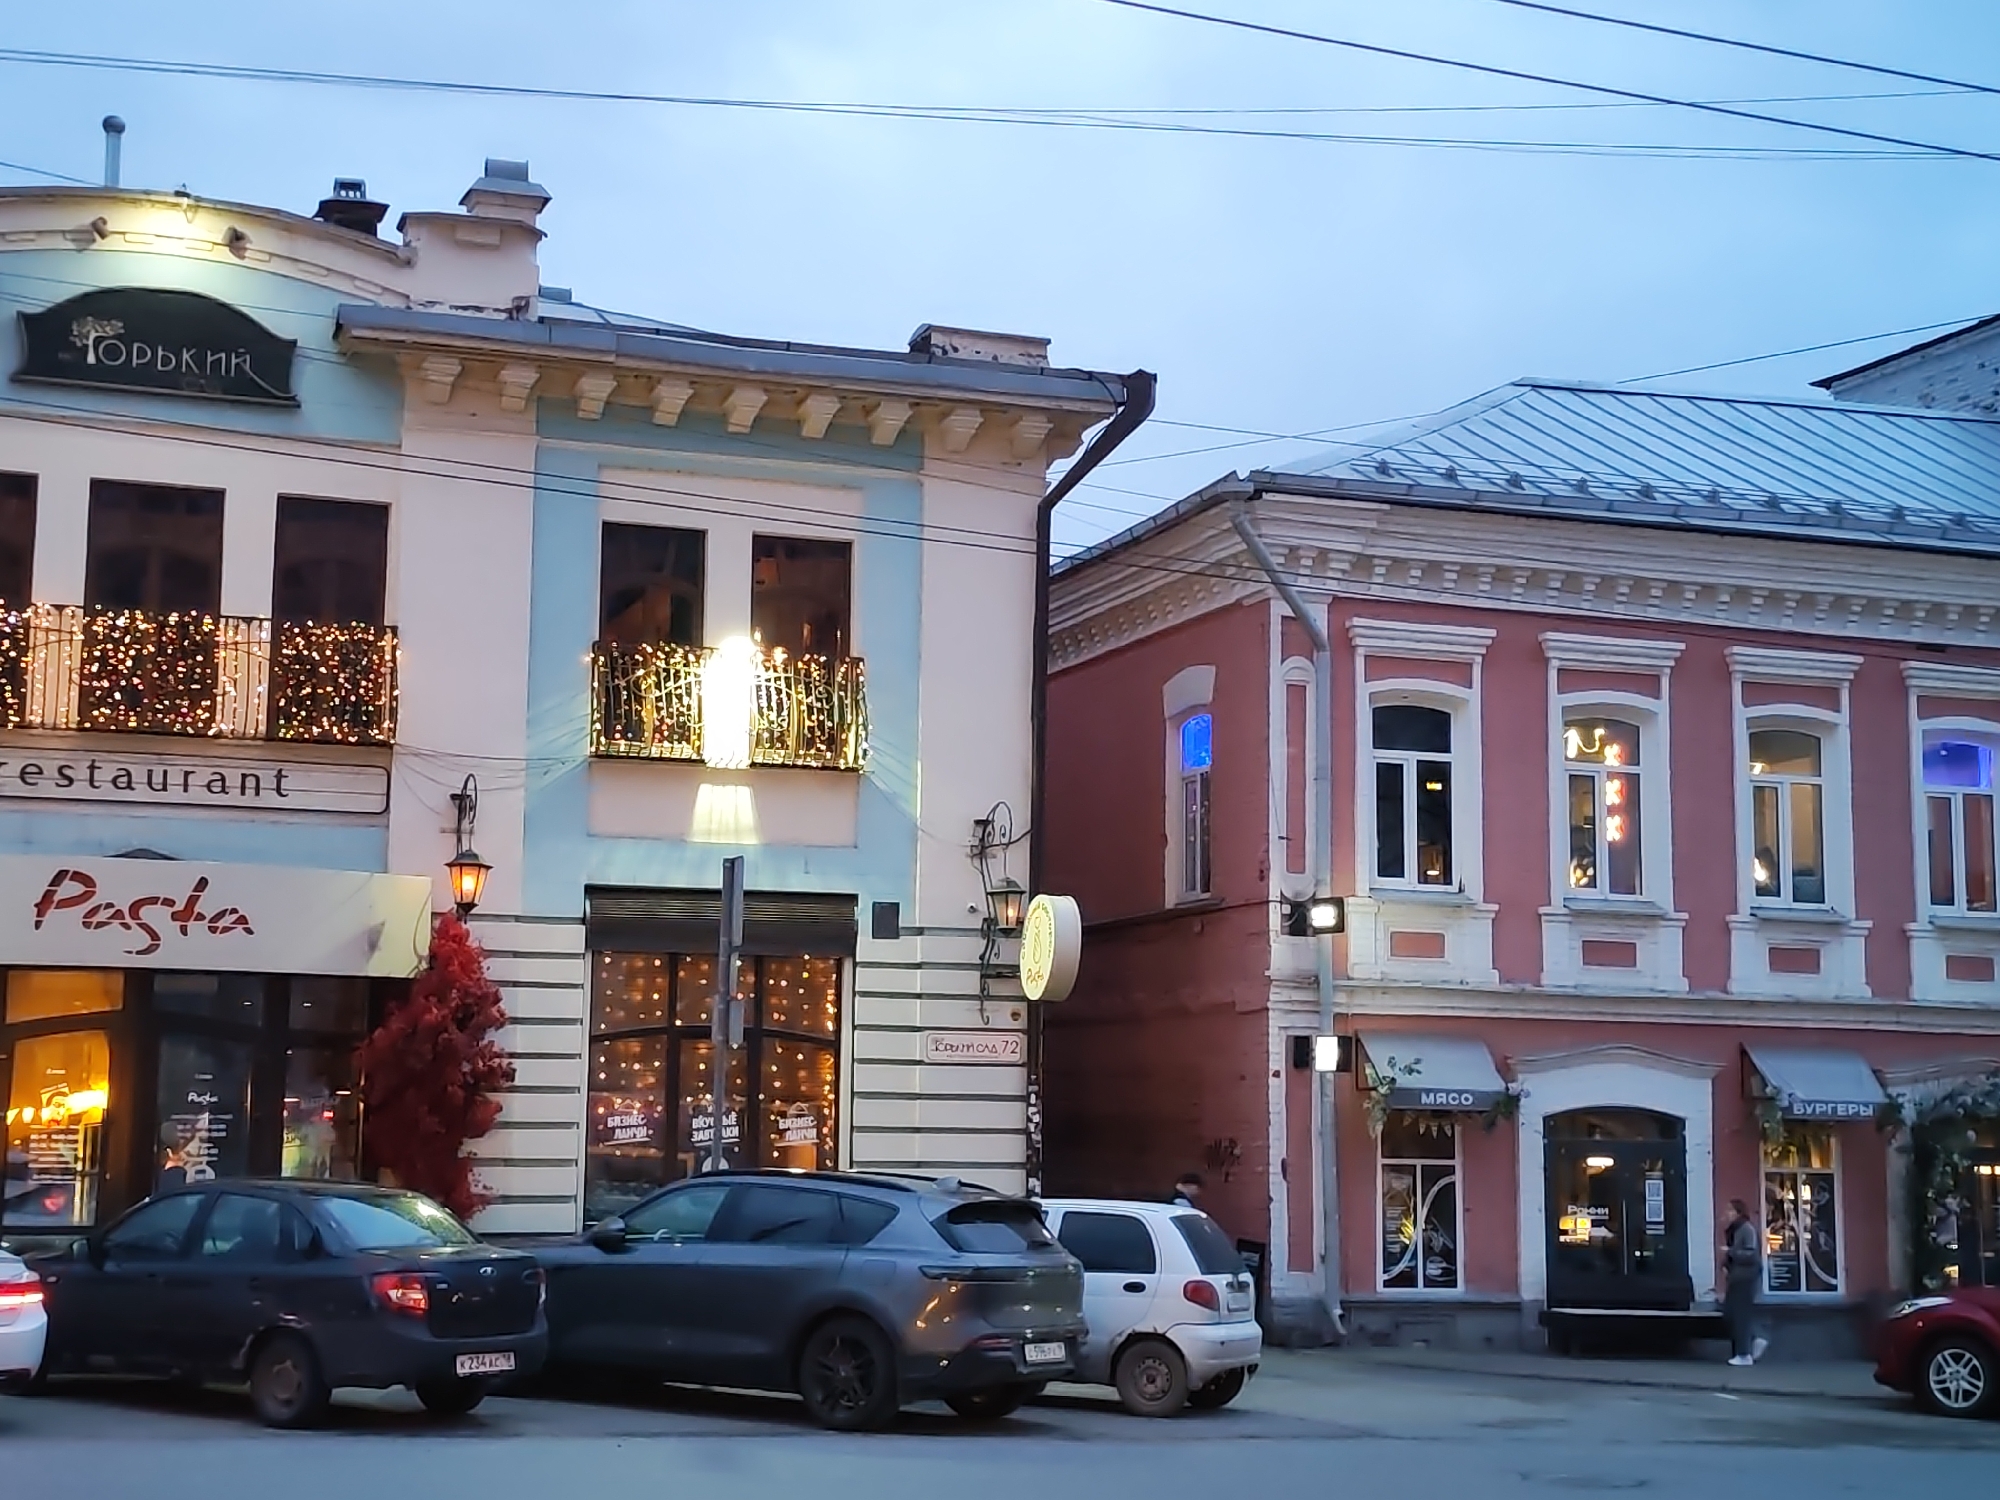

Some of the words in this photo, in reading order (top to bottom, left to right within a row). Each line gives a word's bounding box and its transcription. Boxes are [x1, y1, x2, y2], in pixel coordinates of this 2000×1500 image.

[33, 868, 255, 956] Pasta
[1000, 1039, 1019, 1054] 72
[1421, 1091, 1474, 1106] МЯСО
[1793, 1102, 1874, 1117] БУРГЕРЫ
